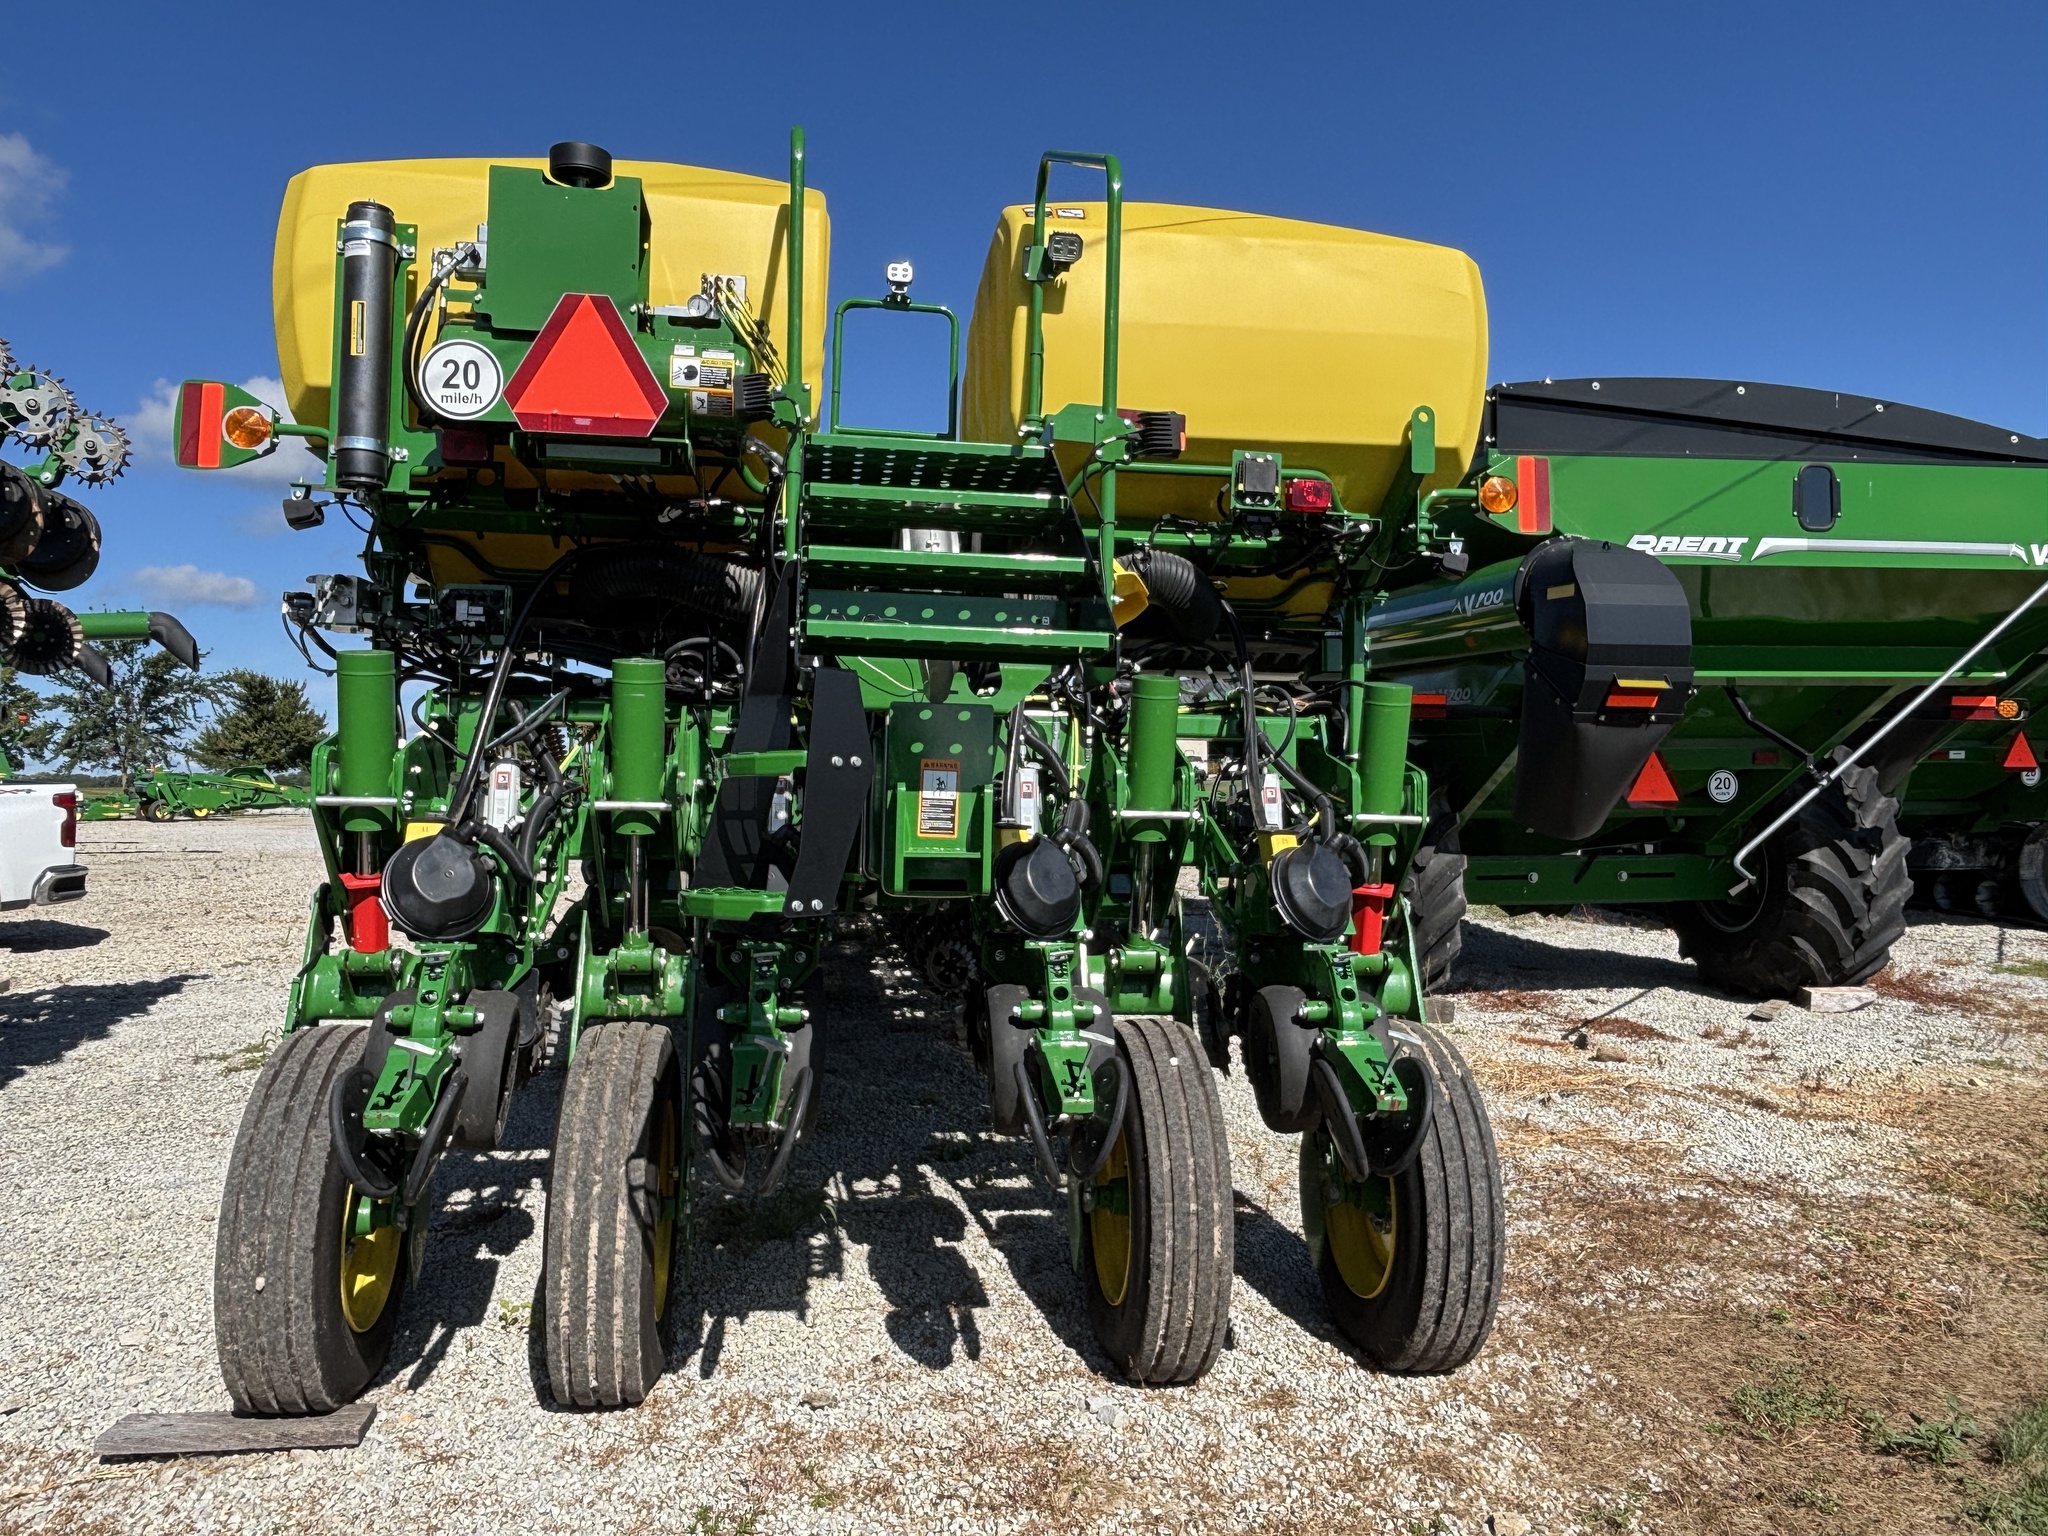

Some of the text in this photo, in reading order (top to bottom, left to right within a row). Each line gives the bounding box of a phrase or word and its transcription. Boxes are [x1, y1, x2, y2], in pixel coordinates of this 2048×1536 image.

[442, 359, 480, 390] 20
[441, 392, 482, 404] mile/h
[1714, 777, 1731, 790] 20
